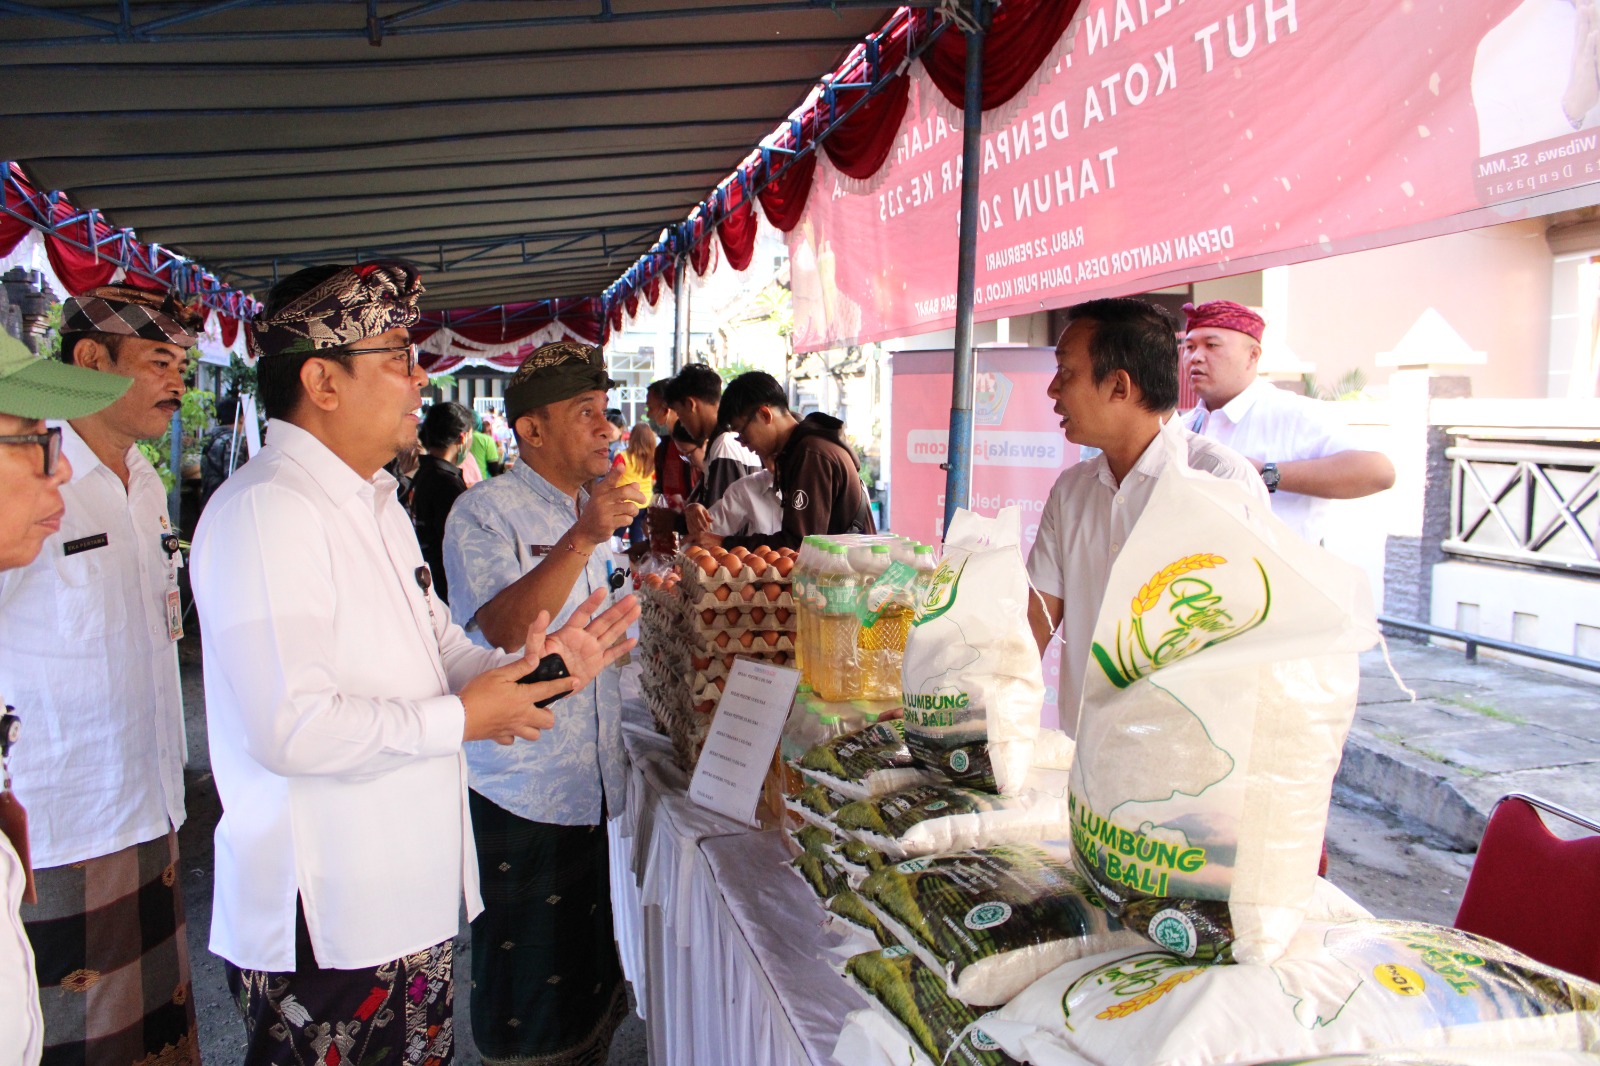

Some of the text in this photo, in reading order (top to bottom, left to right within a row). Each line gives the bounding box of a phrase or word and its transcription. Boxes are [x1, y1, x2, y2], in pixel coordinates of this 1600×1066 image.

[921, 711, 953, 727] BALI
[1080, 805, 1205, 872] LUMBUNG
[1106, 853, 1168, 897] BALI
